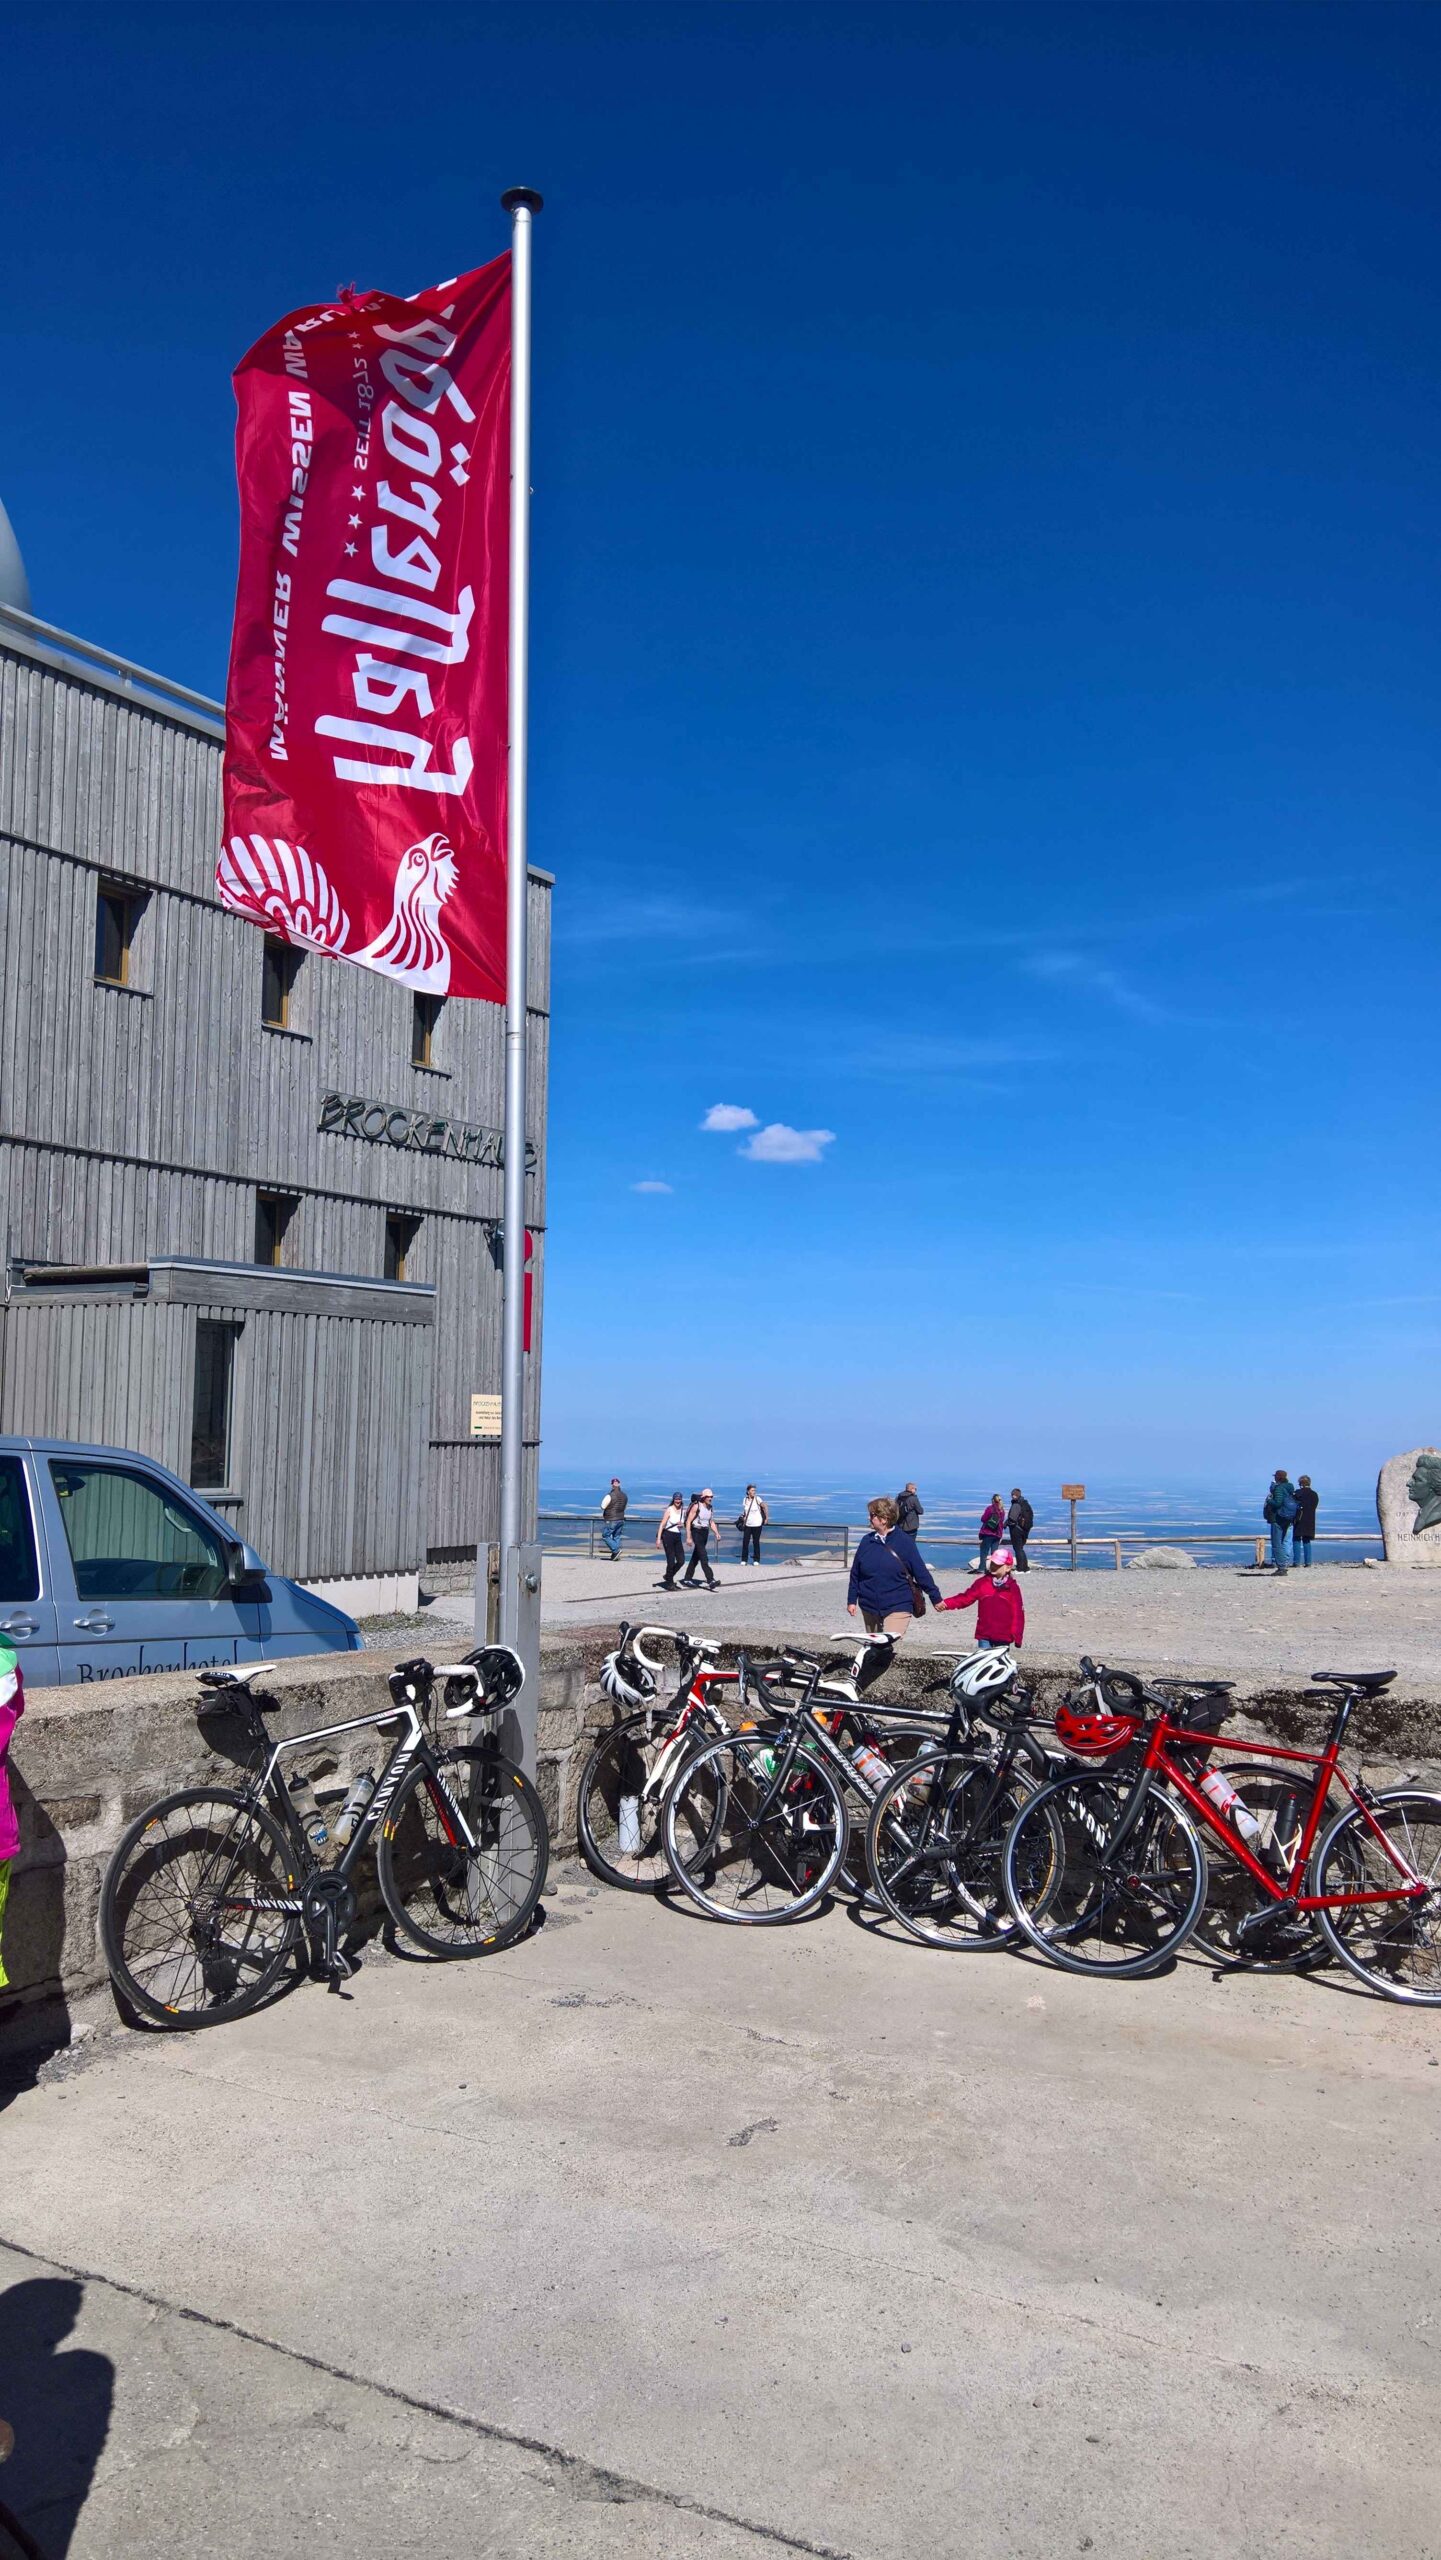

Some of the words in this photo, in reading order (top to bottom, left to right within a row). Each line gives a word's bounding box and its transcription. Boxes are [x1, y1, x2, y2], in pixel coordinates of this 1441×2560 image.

[1397, 1533, 1434, 1542] HEINRICH
[367, 1753, 412, 1821] CANYON
[250, 1899, 299, 1910] CANYON
